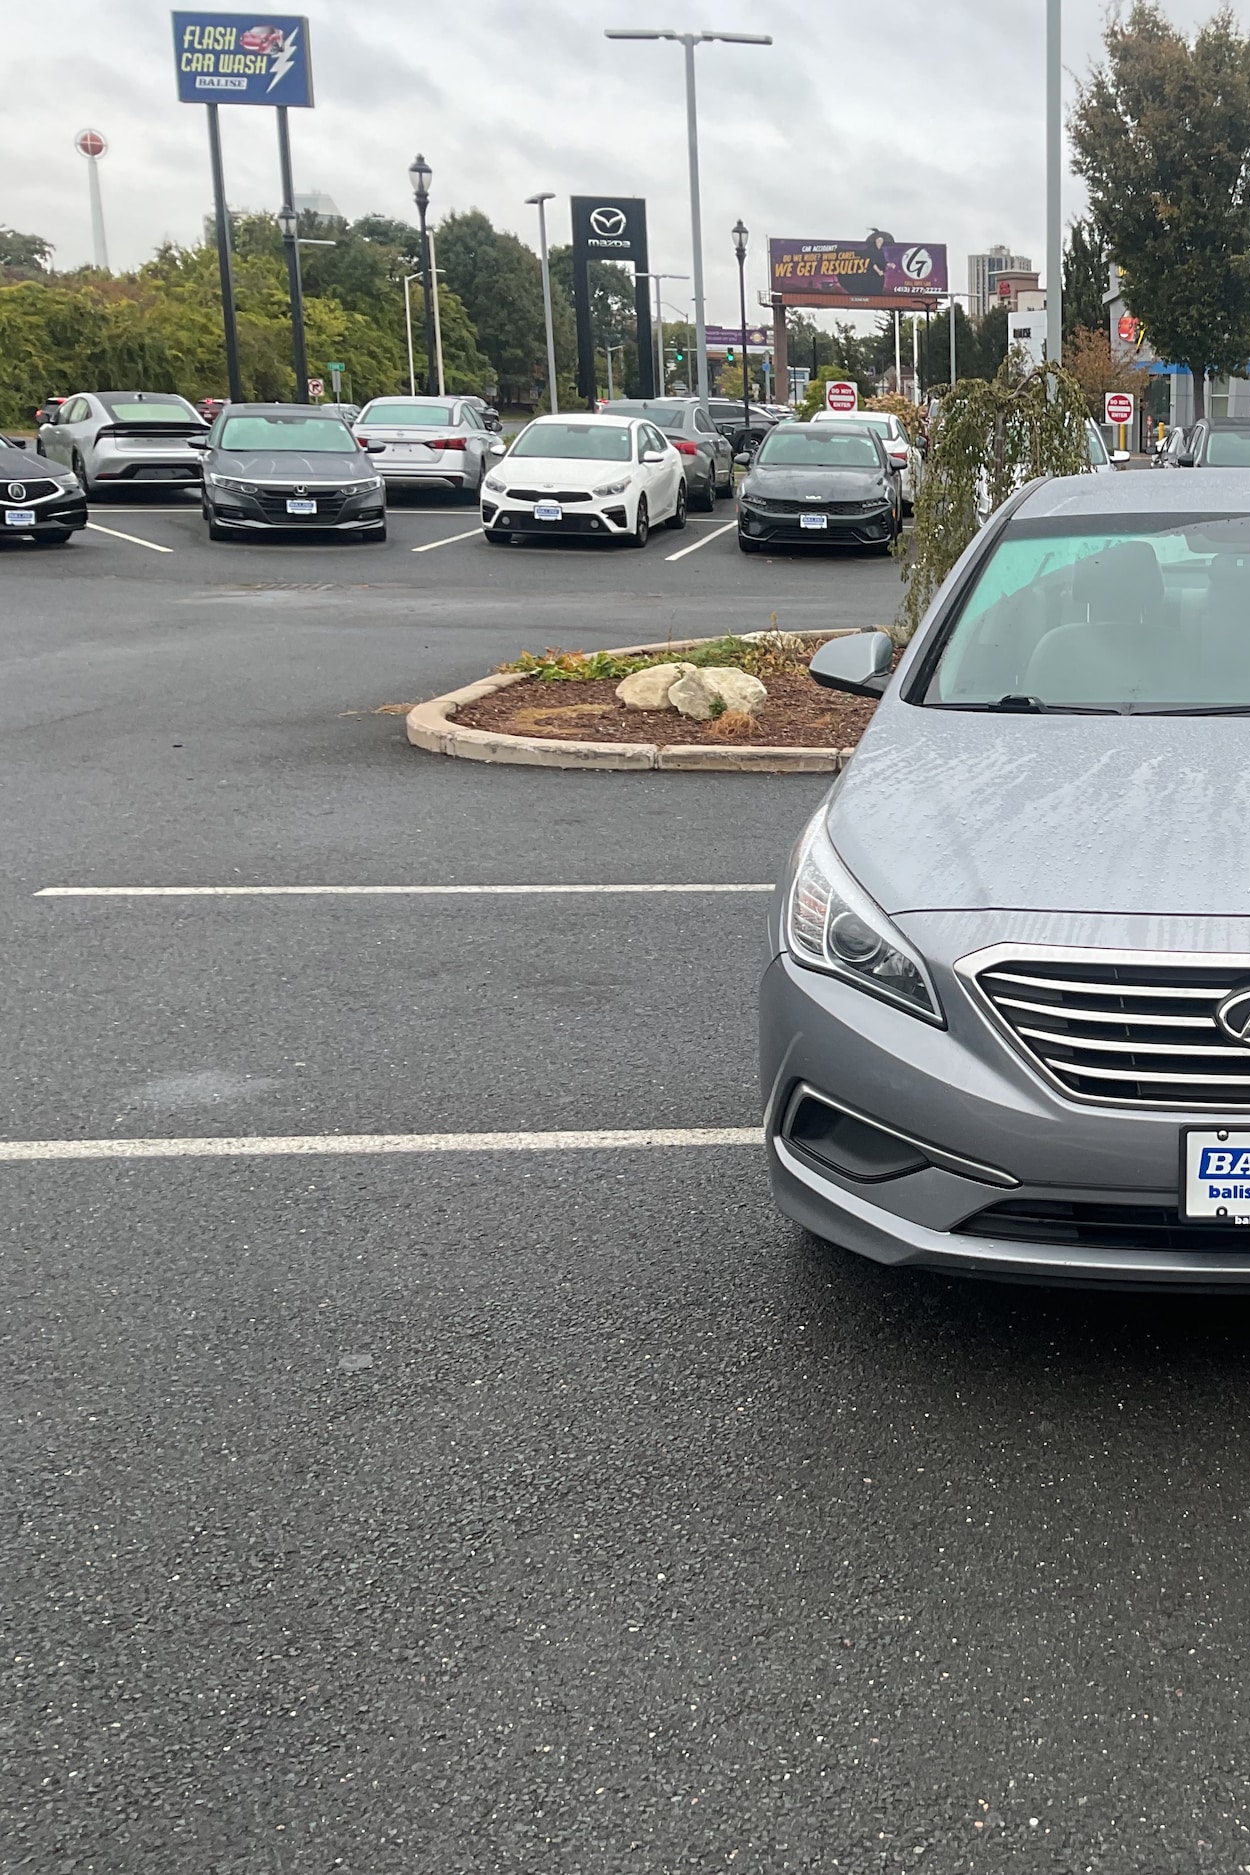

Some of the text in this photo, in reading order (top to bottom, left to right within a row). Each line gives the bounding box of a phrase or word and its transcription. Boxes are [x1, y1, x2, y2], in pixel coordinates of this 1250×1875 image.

[183, 25, 237, 50] FLASH
[181, 53, 267, 75] CAR WASH
[197, 77, 246, 89] BALISE
[812, 244, 838, 252] ACCIDENT?
[775, 258, 870, 277] WE GET RESULTS!
